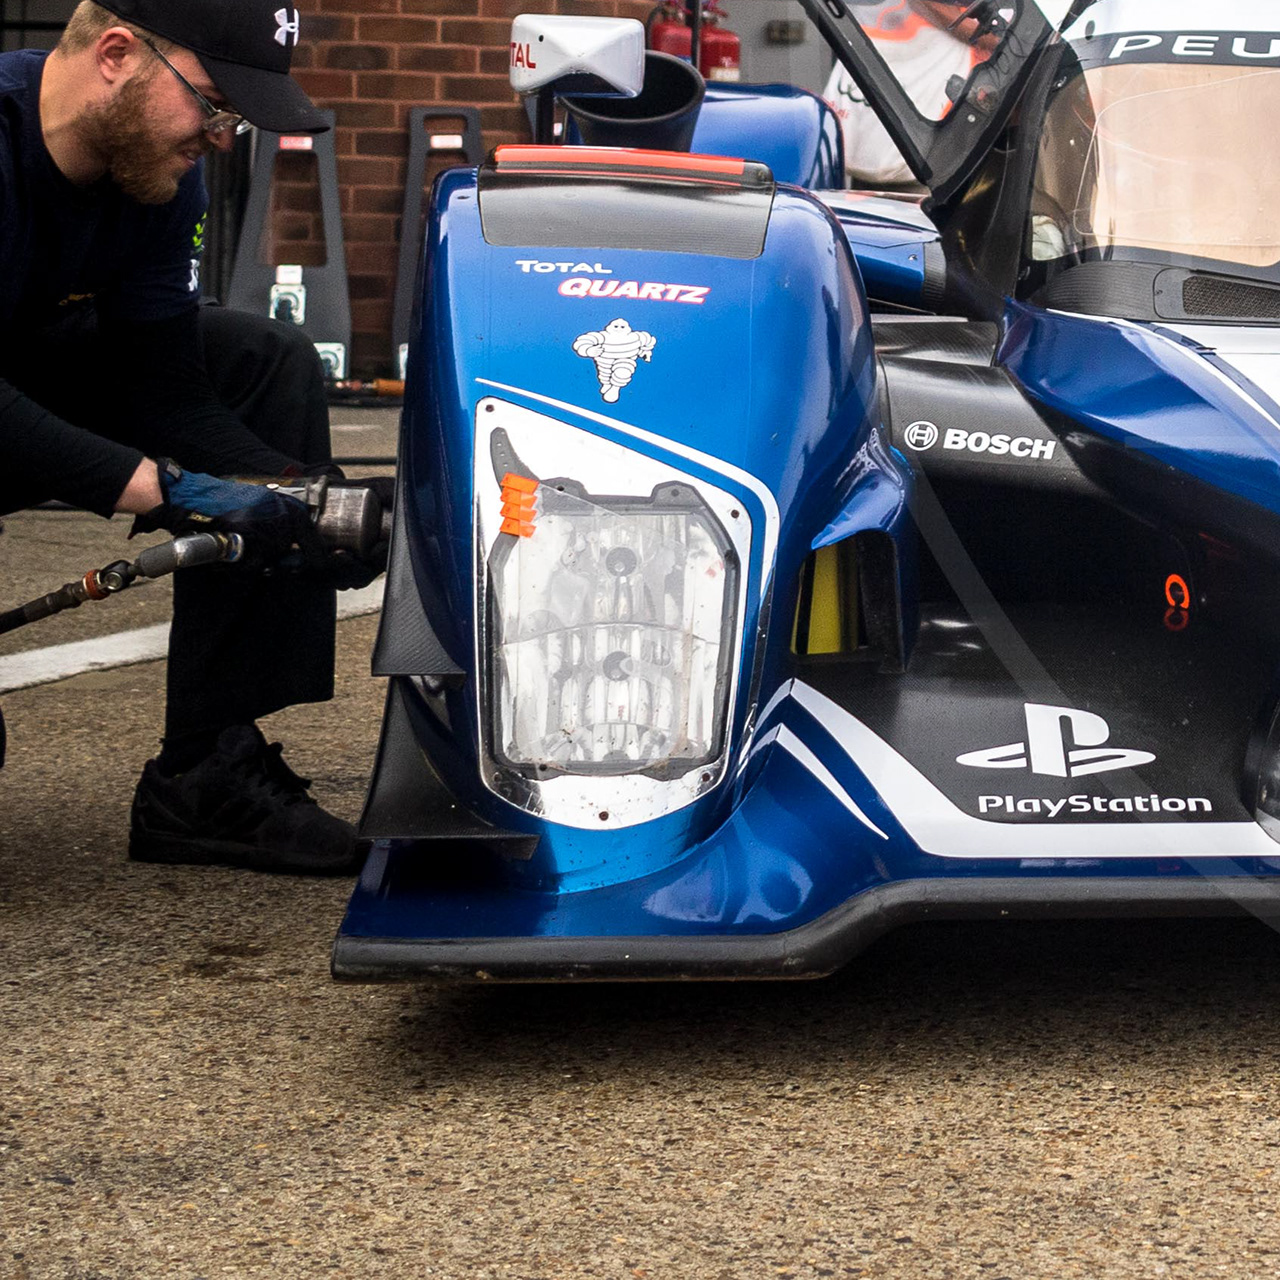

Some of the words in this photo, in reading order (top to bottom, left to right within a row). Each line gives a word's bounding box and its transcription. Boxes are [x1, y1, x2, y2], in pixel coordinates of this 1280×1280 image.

[509, 42, 536, 69] TAL
[515, 260, 613, 274] TOTAL
[558, 277, 711, 304] QUARTZ
[943, 428, 1056, 460] BOSCH
[978, 794, 1212, 818] PlayStation
